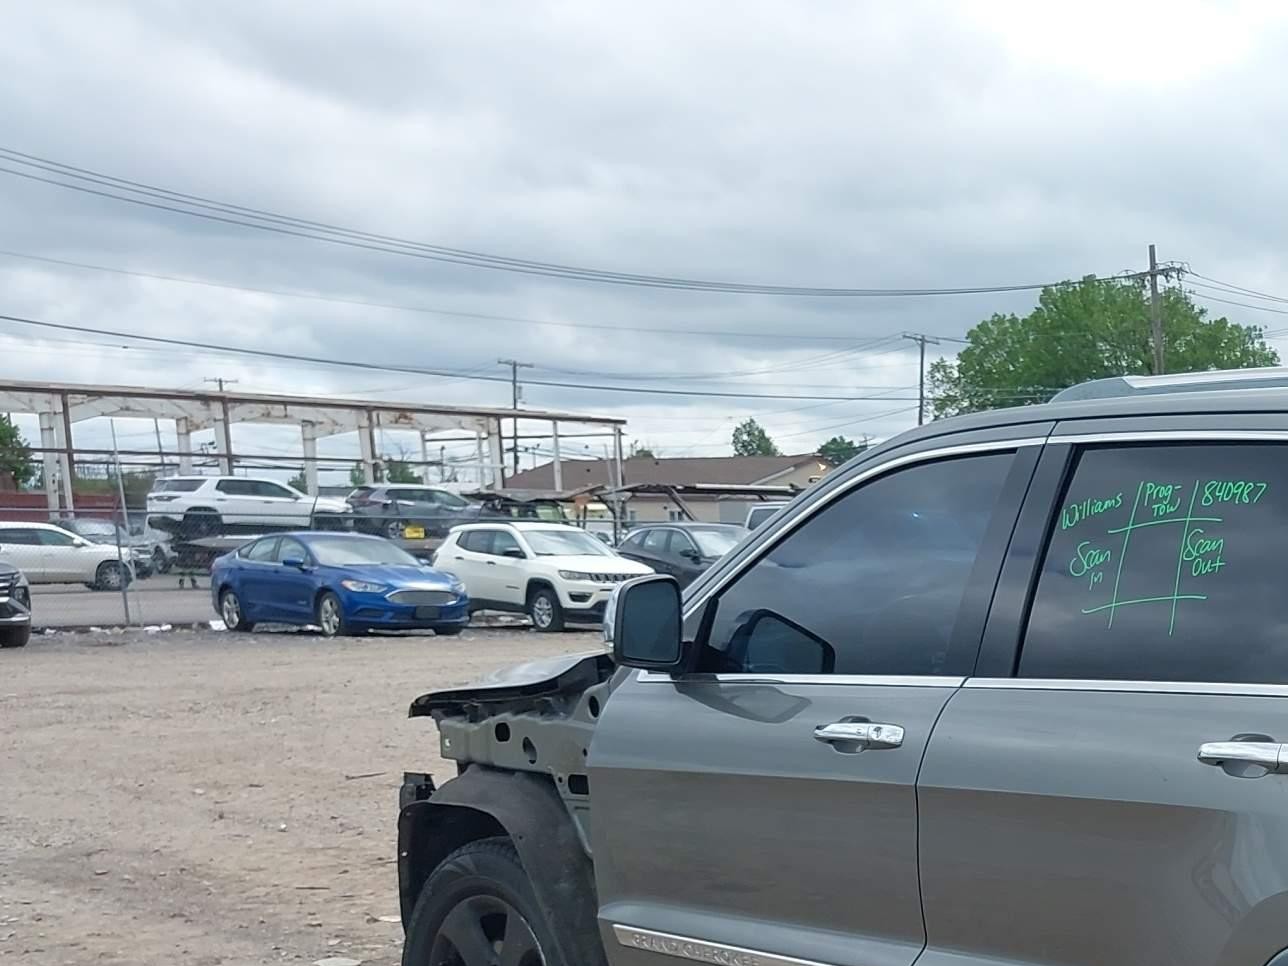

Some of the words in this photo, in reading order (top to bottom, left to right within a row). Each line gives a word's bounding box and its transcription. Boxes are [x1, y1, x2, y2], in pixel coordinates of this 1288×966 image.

[1201, 479, 1267, 506] 840987
[1061, 492, 1123, 530] Williams
[1069, 541, 1111, 577] Scan
[1183, 528, 1224, 561] Scan
[631, 932, 678, 953] GRAND
